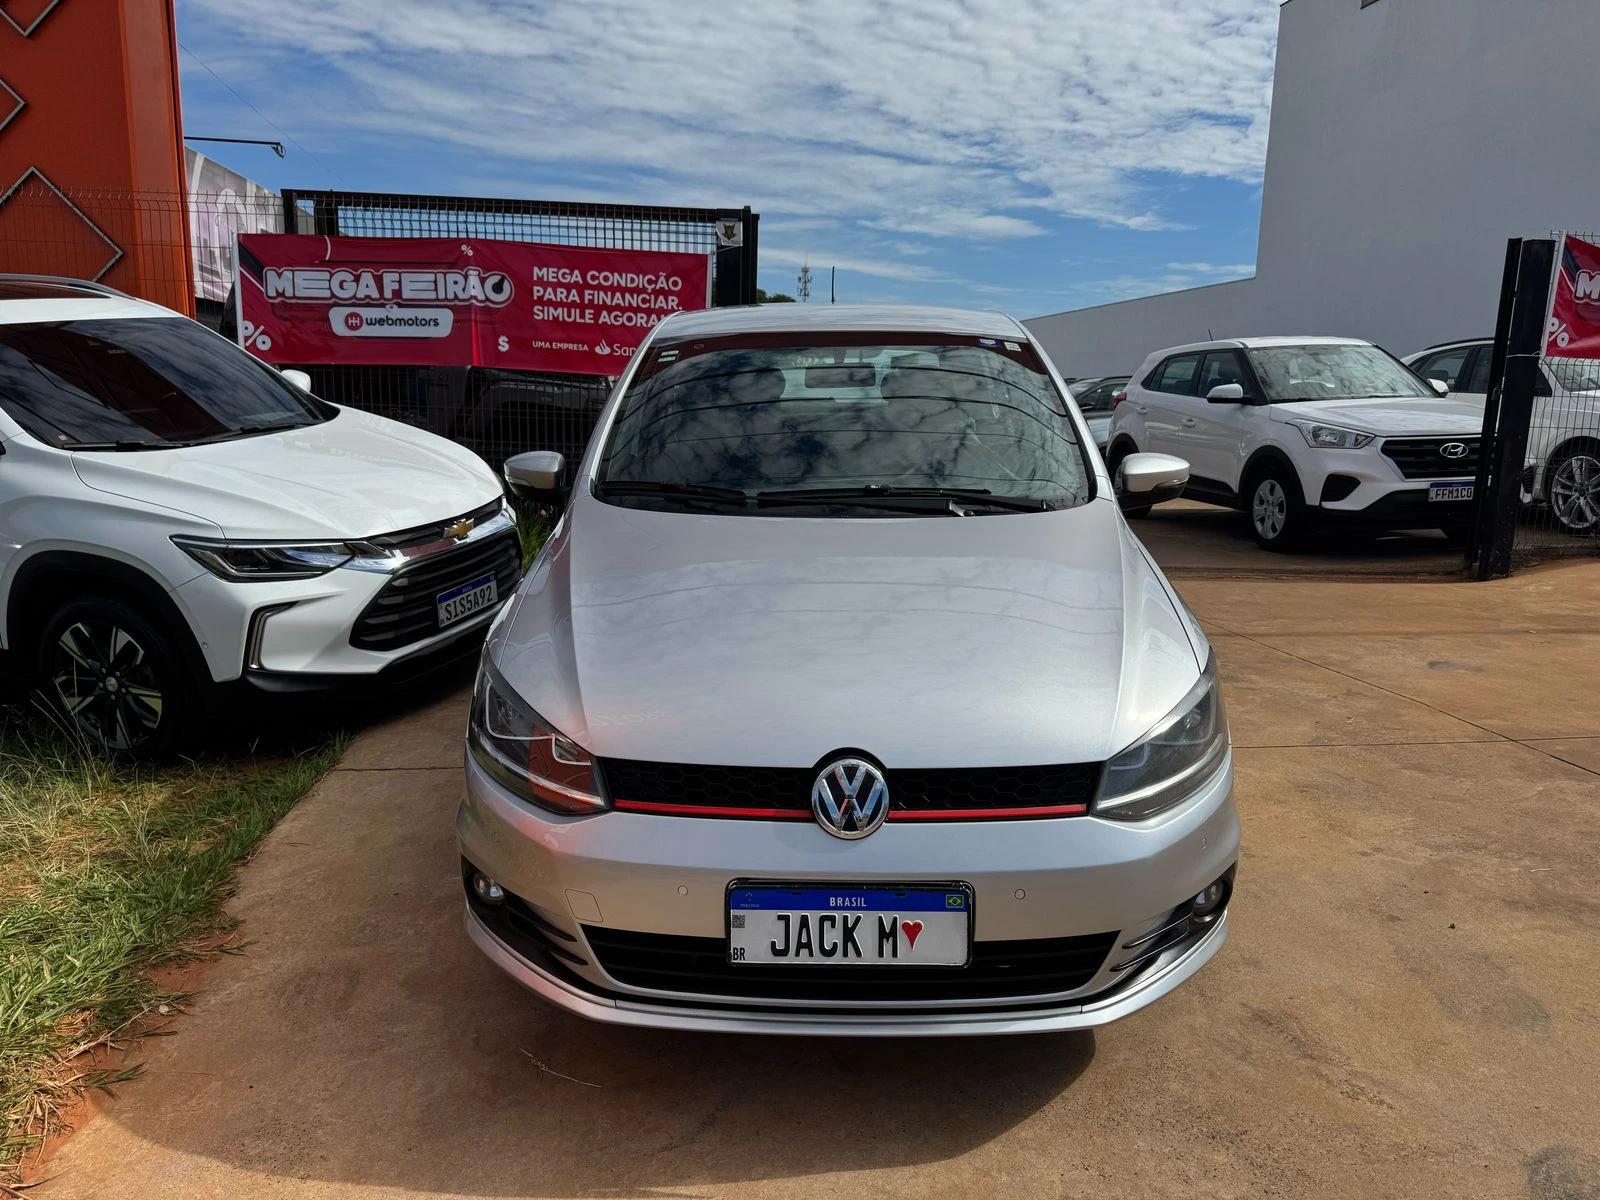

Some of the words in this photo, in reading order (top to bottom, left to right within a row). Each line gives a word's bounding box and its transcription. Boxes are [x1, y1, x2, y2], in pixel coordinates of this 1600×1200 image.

[533, 266, 583, 284] MEGA
[587, 270, 683, 293] CONDIÇÃO
[533, 286, 580, 303] PARA
[584, 290, 683, 311] FINANCIAR.
[365, 315, 440, 327] webmotors
[533, 305, 595, 324] SIMULE
[532, 340, 551, 349] UMA
[552, 342, 588, 351] EMPRESA
[445, 585, 493, 620] SIS5A92
[829, 896, 867, 907] BRASIL
[770, 913, 864, 958] JACK
[733, 947, 746, 961] BR
